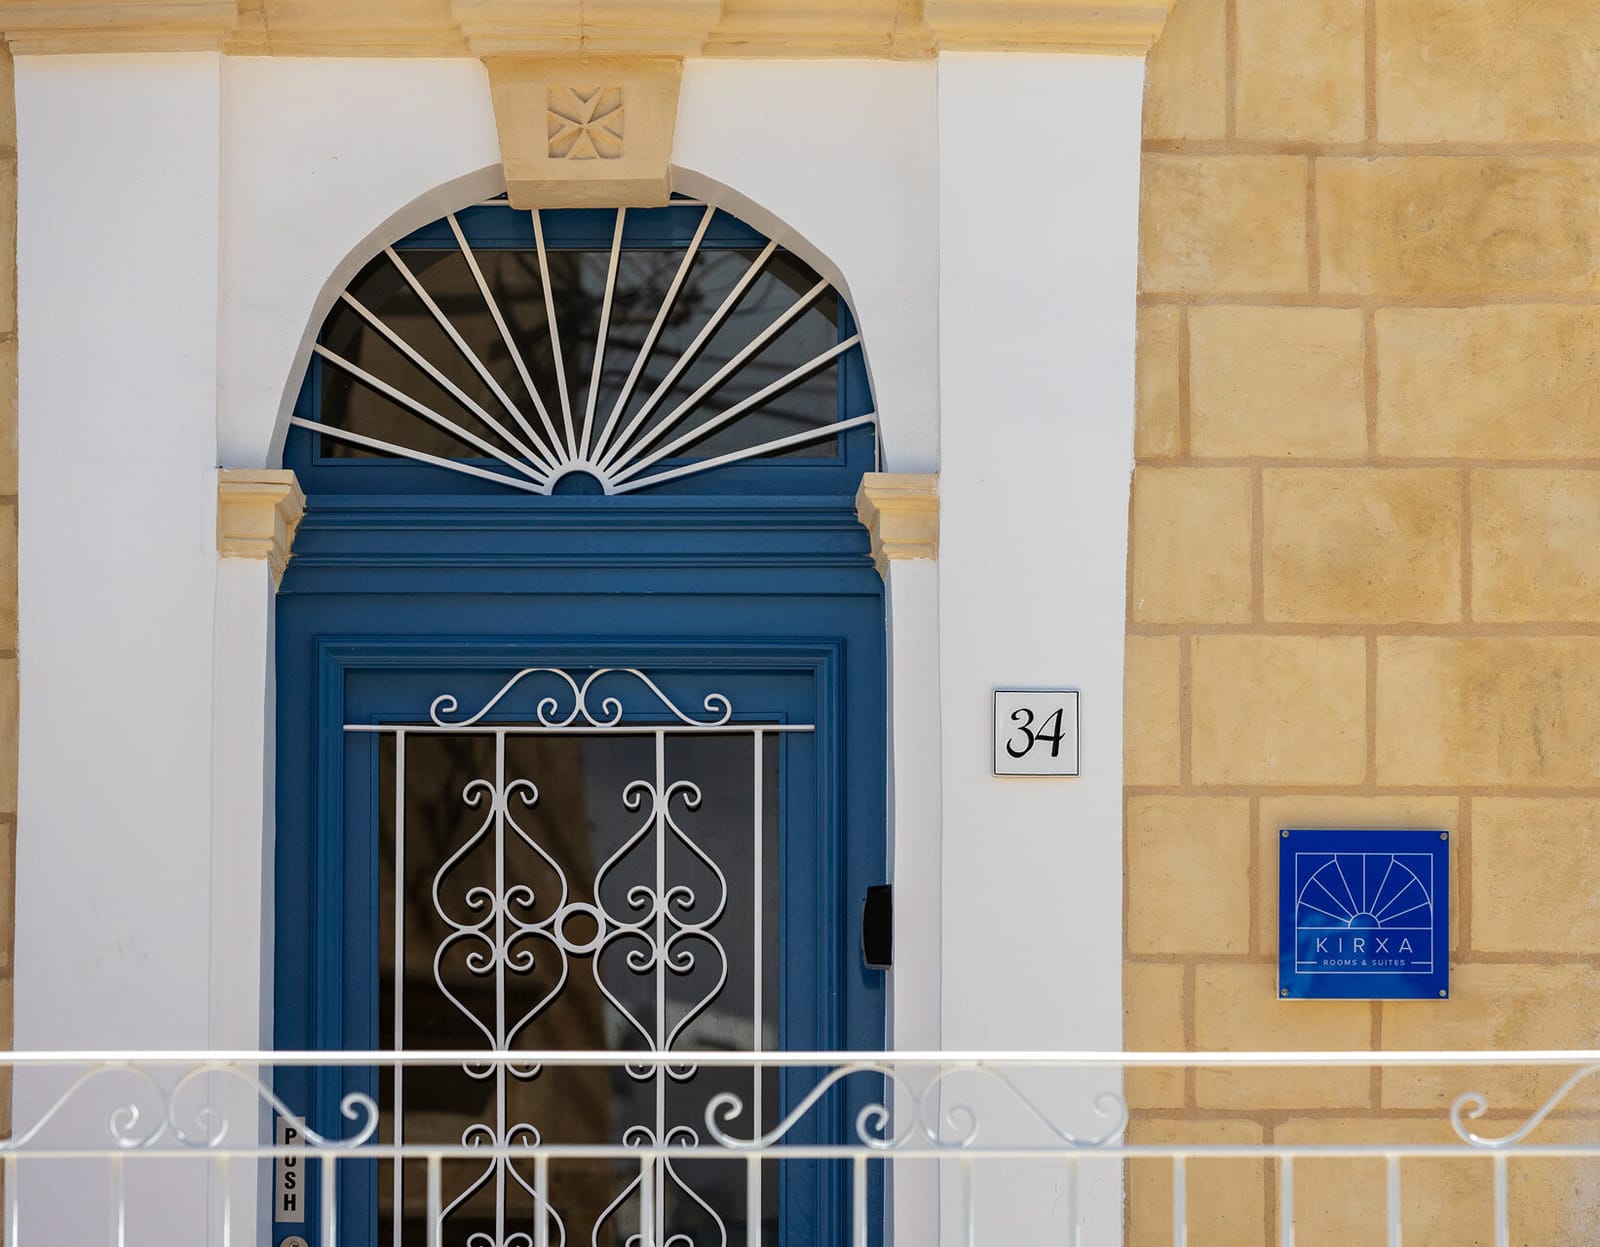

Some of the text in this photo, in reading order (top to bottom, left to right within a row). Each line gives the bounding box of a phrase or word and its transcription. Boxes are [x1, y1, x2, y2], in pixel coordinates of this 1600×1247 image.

[1006, 708, 1066, 758] 34
[1316, 937, 1413, 953] KIRXA
[283, 1127, 297, 1211] PUSH
